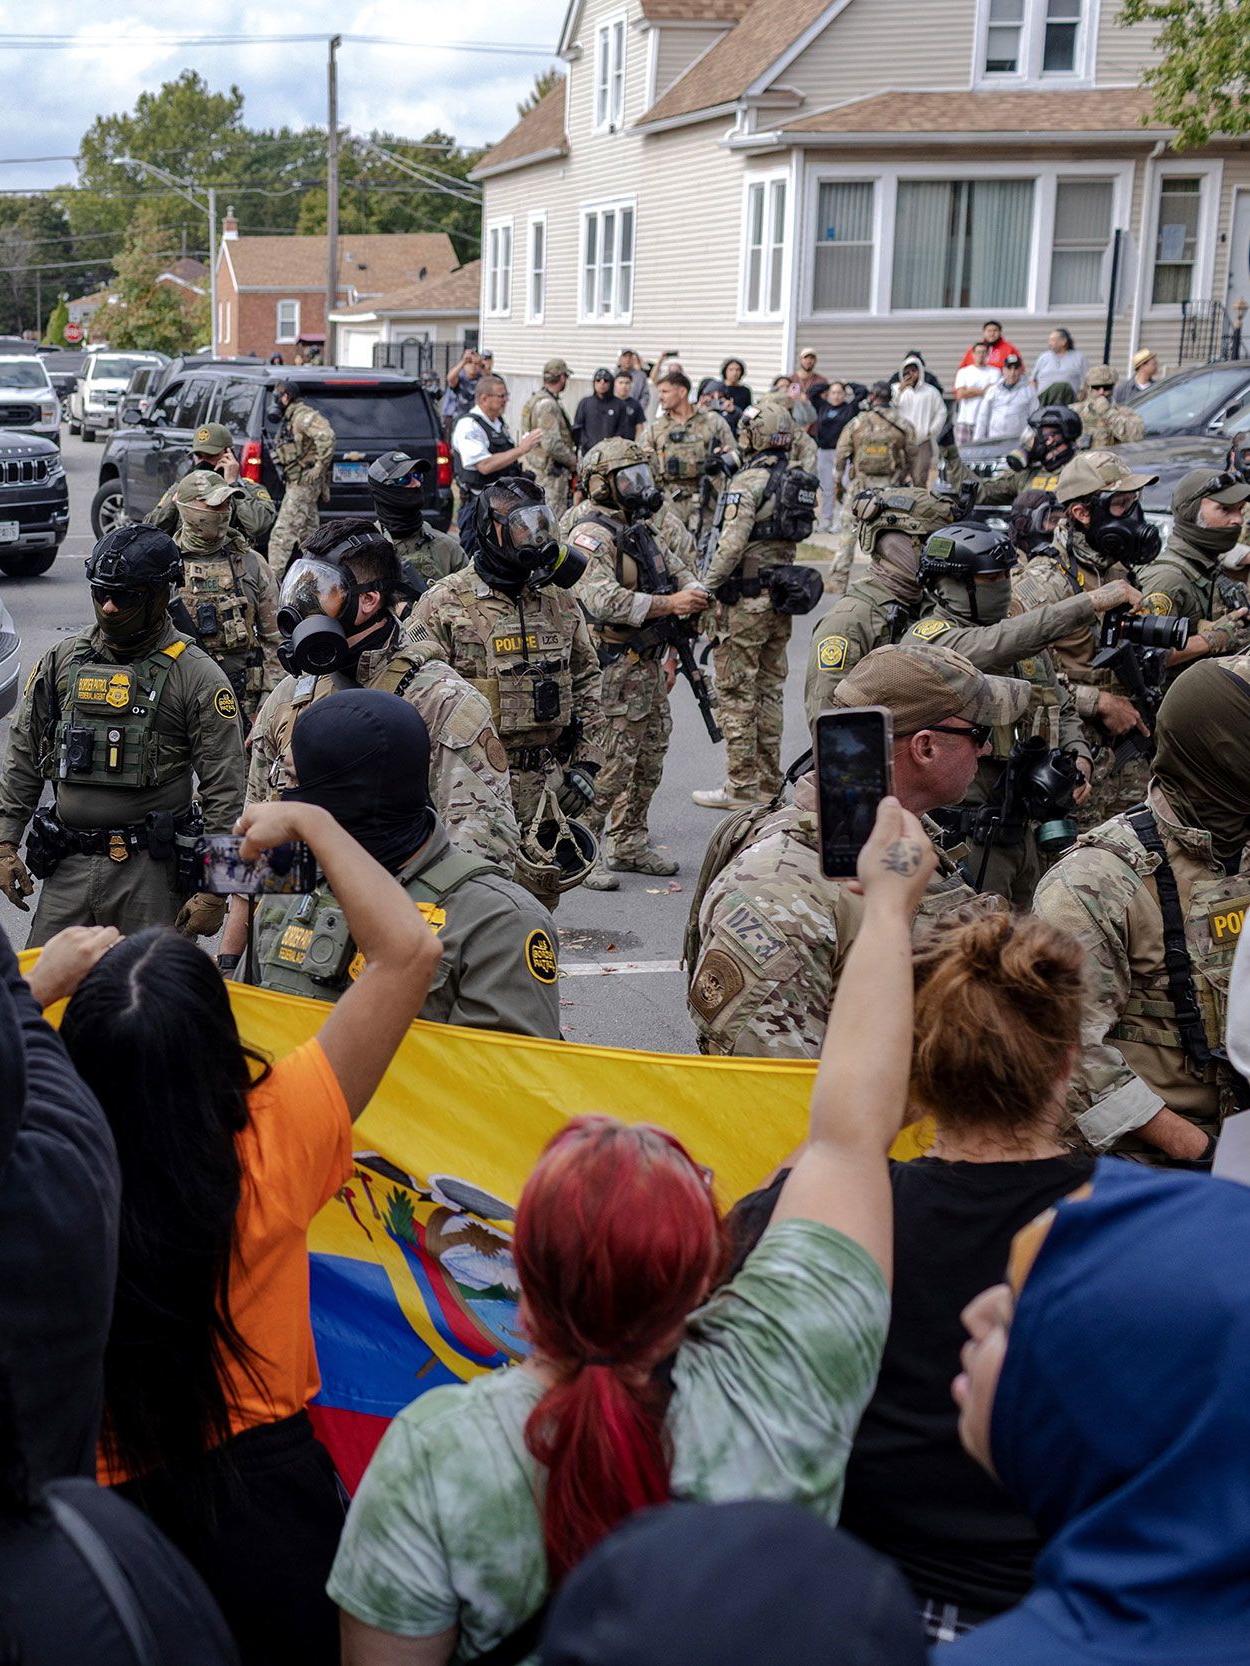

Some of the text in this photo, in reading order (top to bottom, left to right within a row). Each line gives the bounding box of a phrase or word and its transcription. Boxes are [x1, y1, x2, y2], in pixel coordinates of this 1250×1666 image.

[78, 678, 107, 692] BORDER PATROL
[78, 691, 106, 700] FEDERAL AGENT
